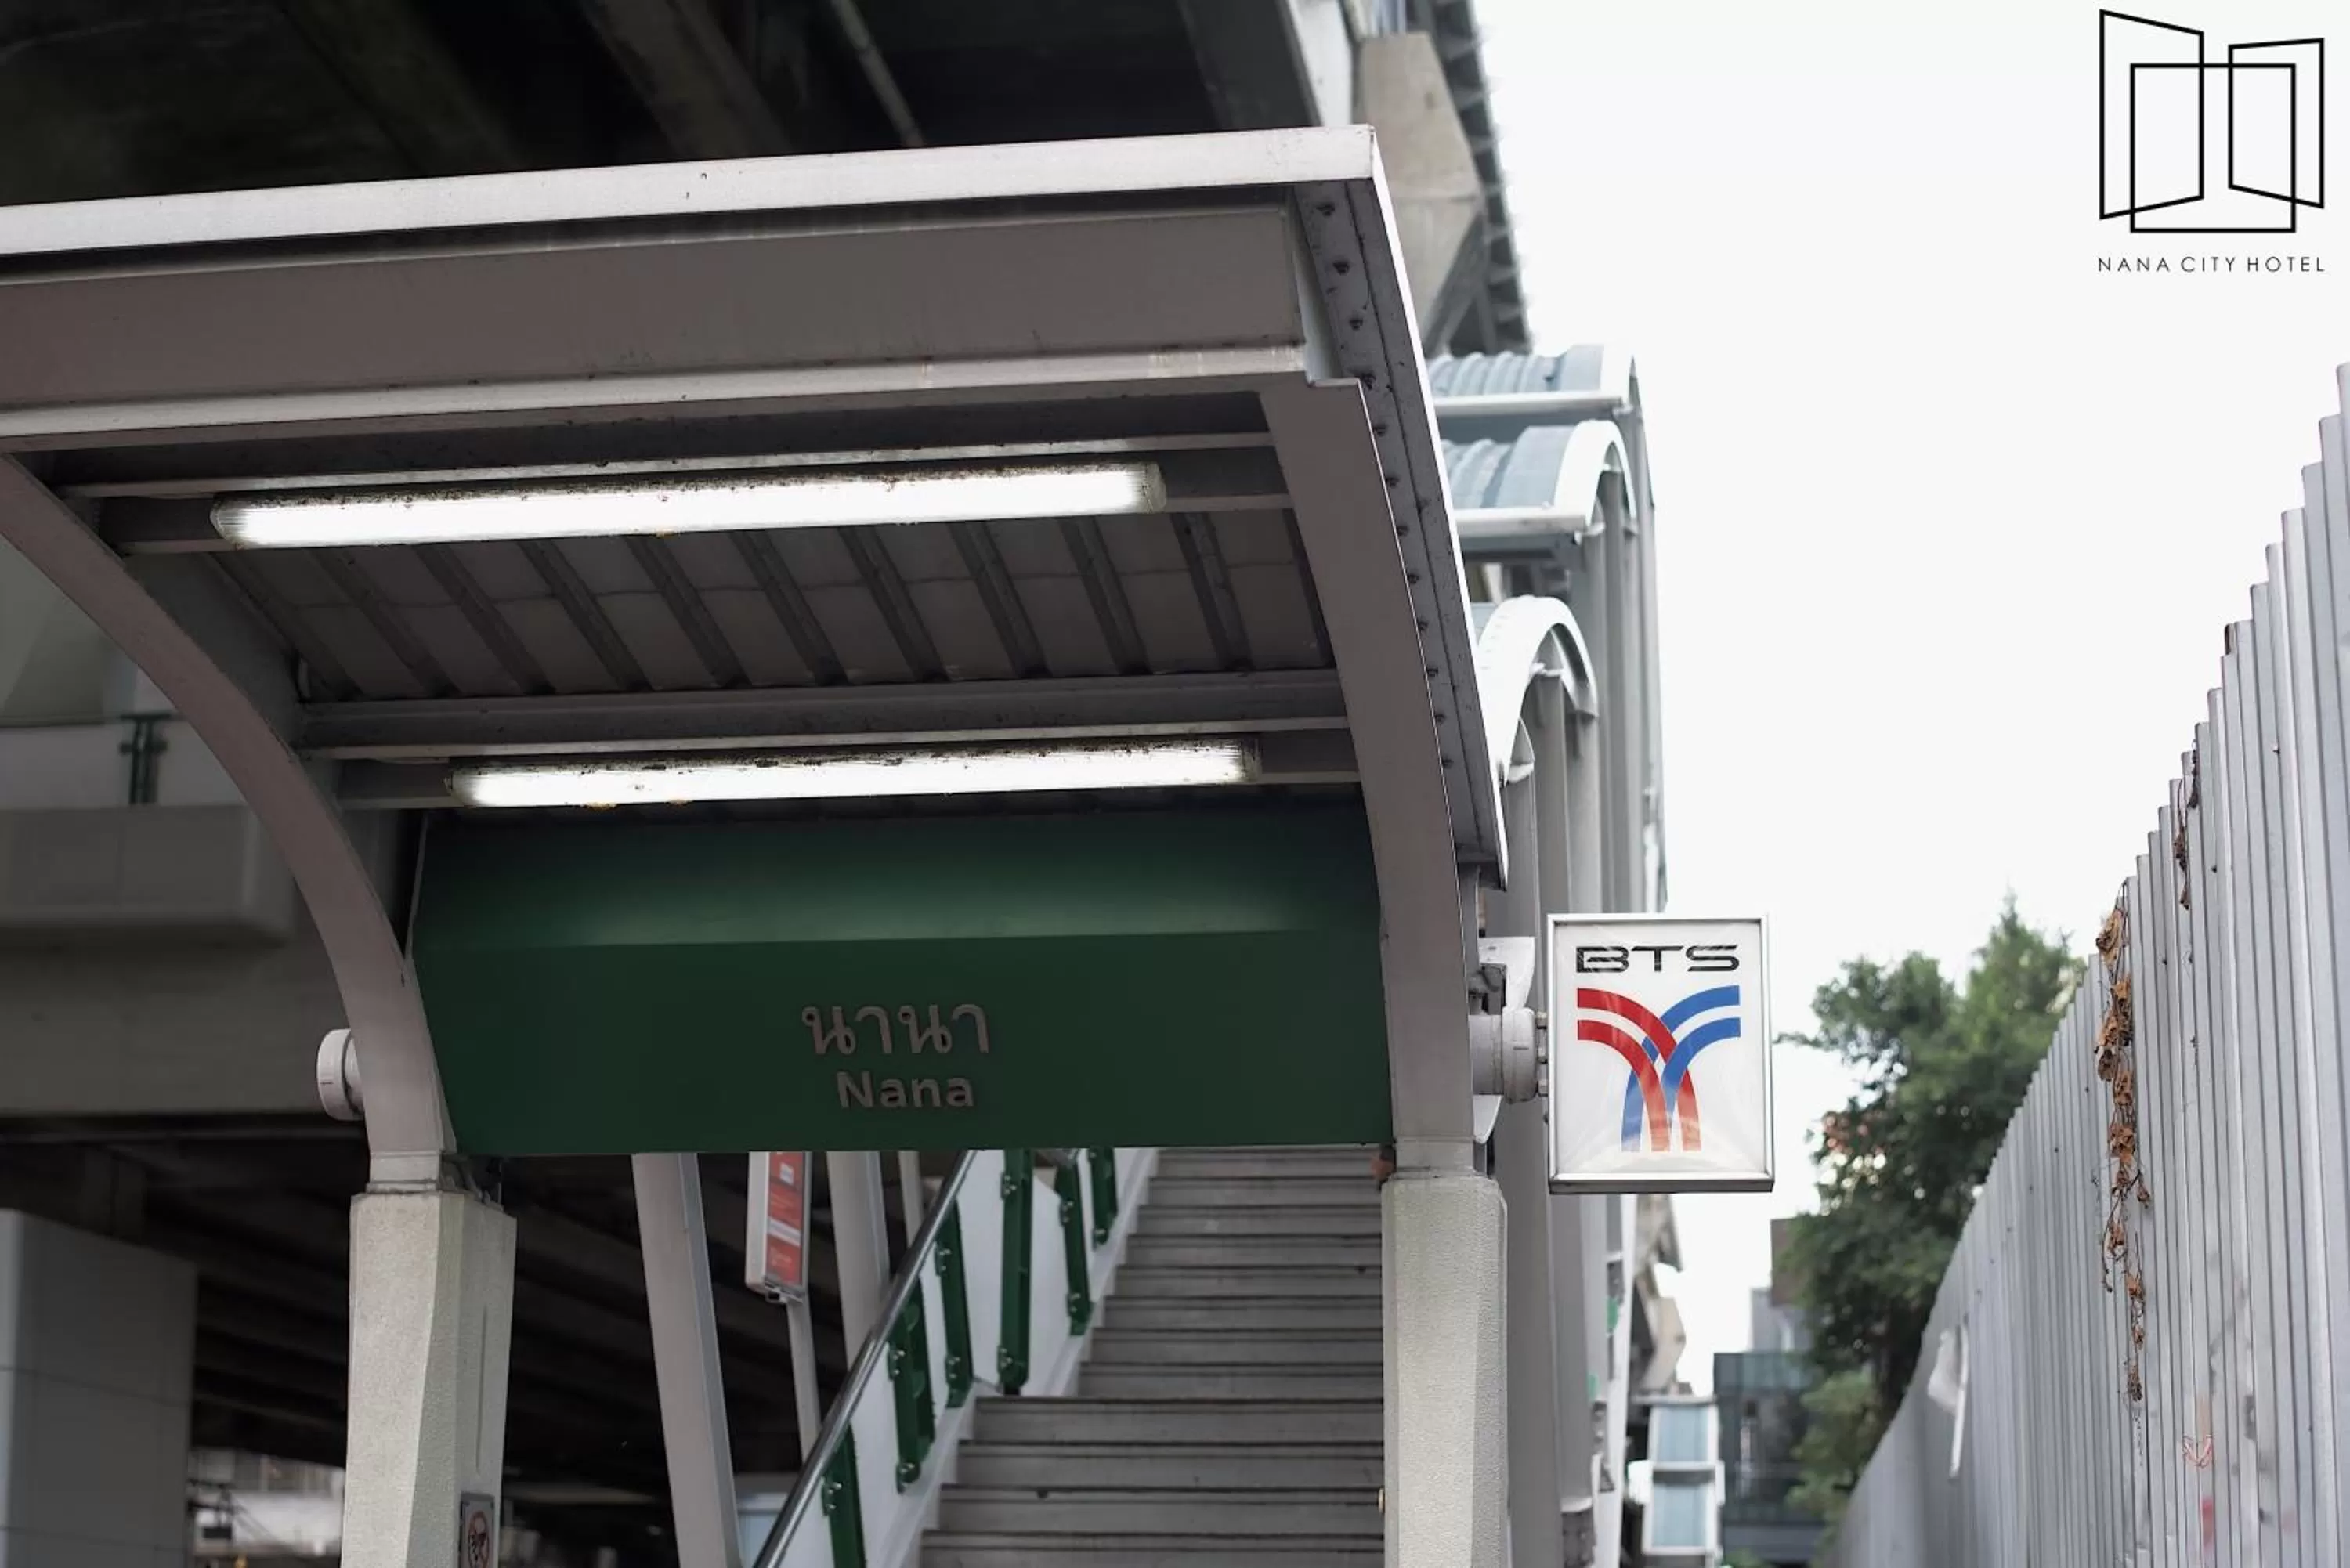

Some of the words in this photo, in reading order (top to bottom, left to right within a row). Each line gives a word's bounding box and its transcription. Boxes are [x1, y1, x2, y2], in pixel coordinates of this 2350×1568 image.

[1575, 944, 1740, 974] BTS
[801, 1003, 989, 1055] นานา
[836, 1070, 974, 1109] Nana
